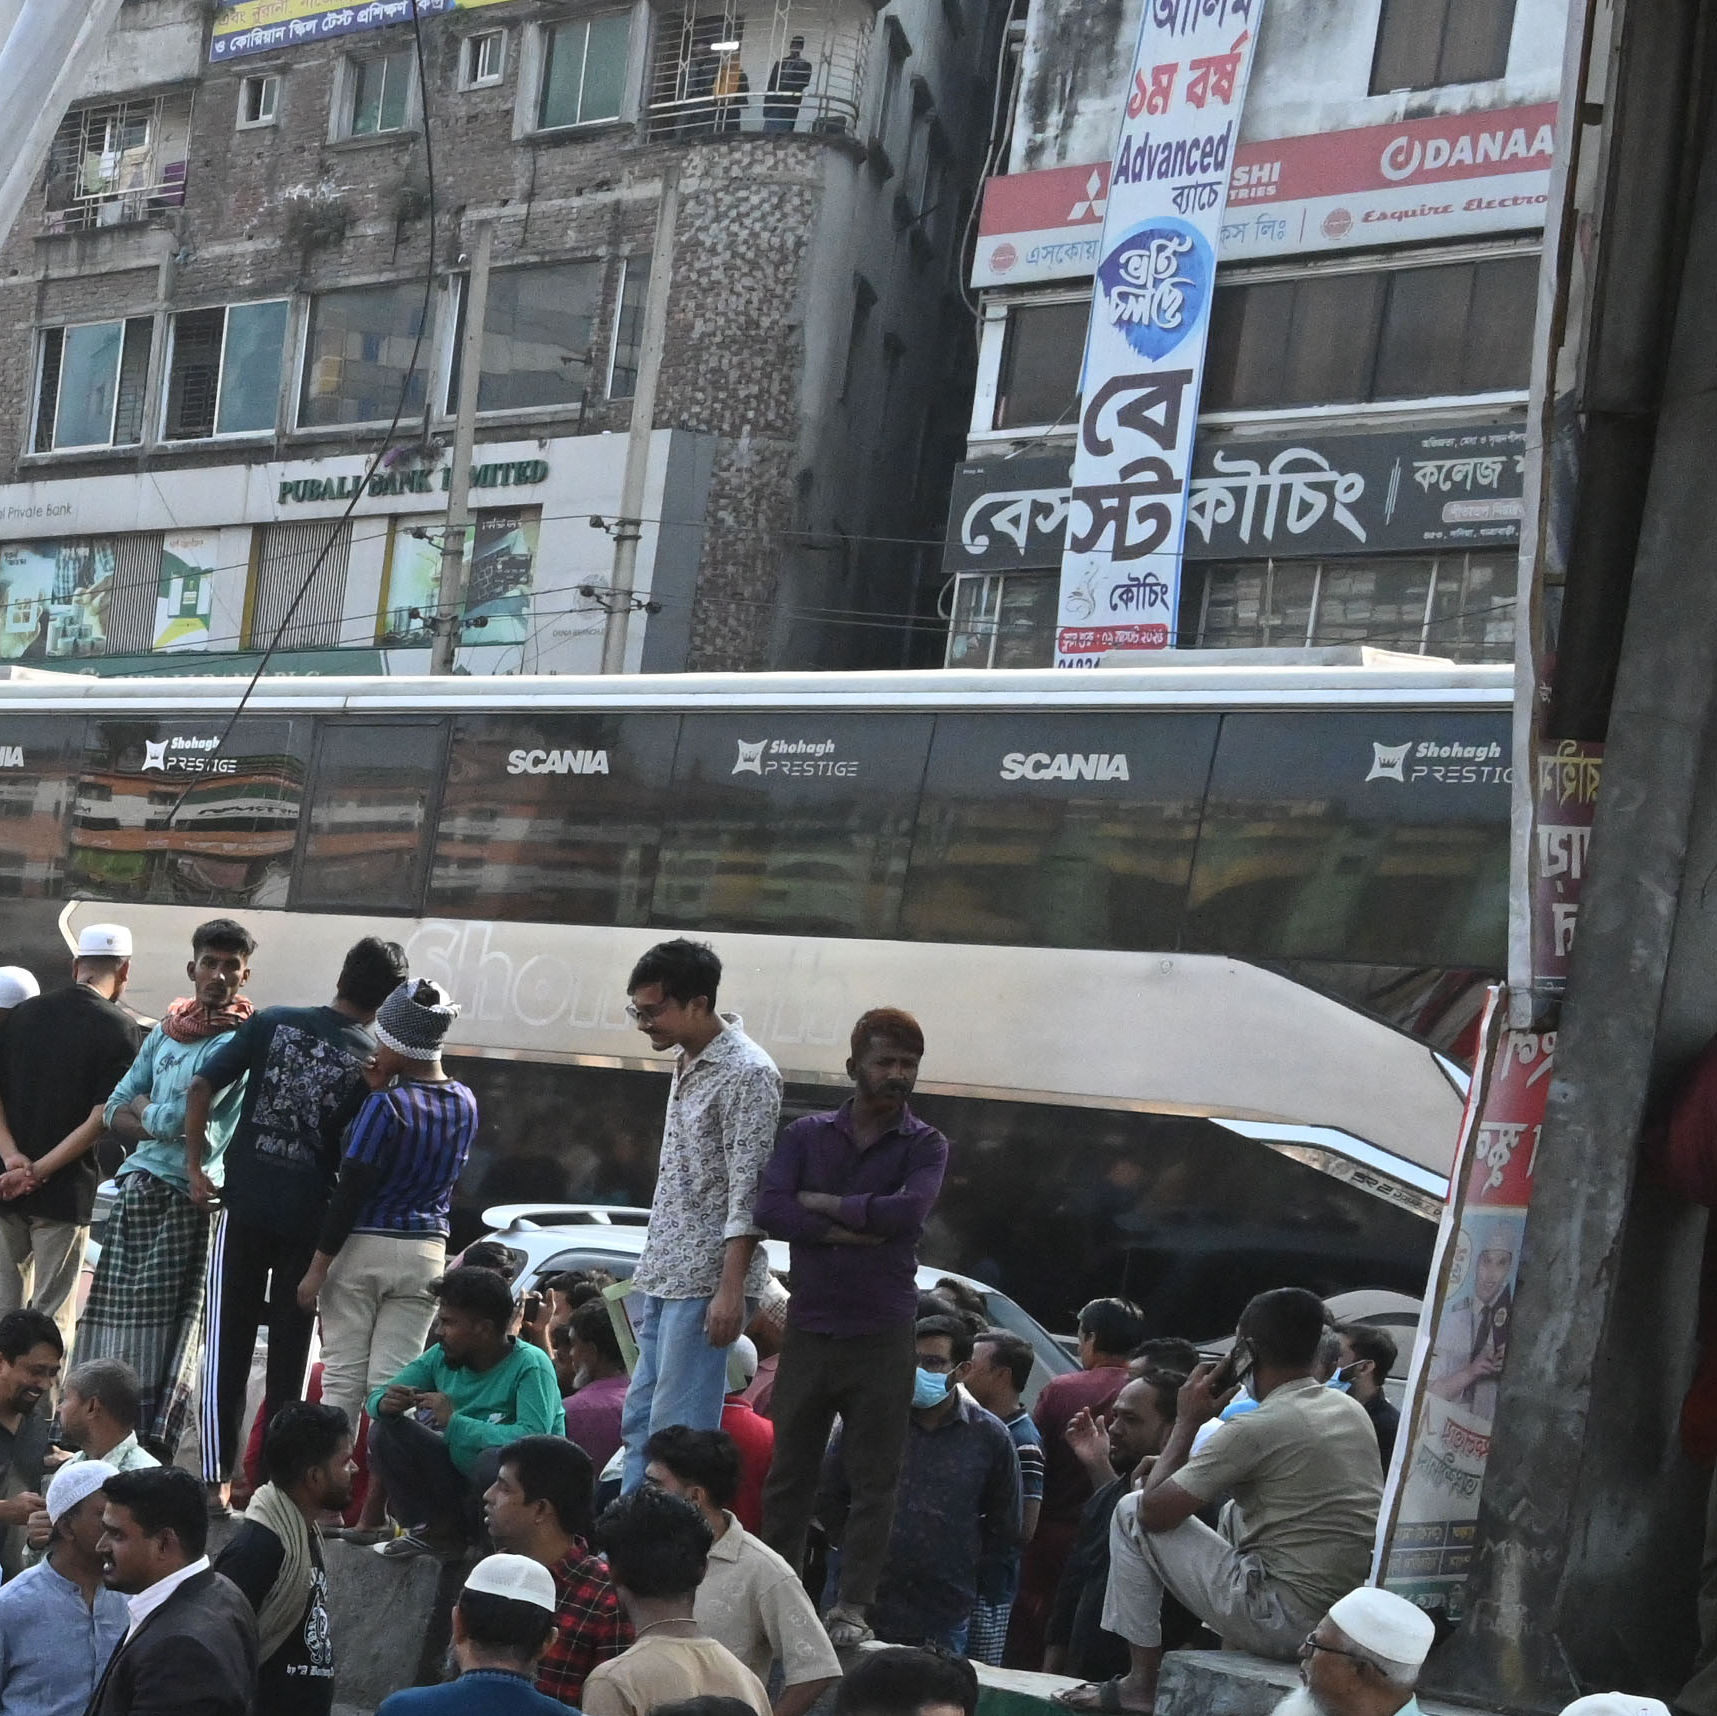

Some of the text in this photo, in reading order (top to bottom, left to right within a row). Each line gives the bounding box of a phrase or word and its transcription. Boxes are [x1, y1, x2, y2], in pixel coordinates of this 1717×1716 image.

[215, 41, 224, 53] ও
[229, 25, 285, 52] কোরিয়ান
[322, 10, 354, 32] টেস্ট
[1127, 29, 1252, 120] ১ম বর্ষ
[1113, 120, 1233, 186] Advanced
[1172, 181, 1223, 216] ব্যাচে
[1361, 204, 1454, 224] Esquire
[1119, 236, 1193, 280] ভর্তি
[1107, 278, 1197, 329] চলছে
[277, 468, 434, 505] PUBALI BANK
[1413, 456, 1508, 493] কলেজ
[8, 505, 44, 519] Private
[46, 502, 72, 516] Bank
[170, 736, 219, 750] Shohagh
[769, 739, 836, 757] Shohagh
[1414, 741, 1502, 760] Shohagh
[166, 756, 237, 774] PRESTIGE
[506, 749, 610, 775] SCANIA
[765, 760, 859, 777] PRESTIGE
[999, 752, 1130, 781] SCANIA
